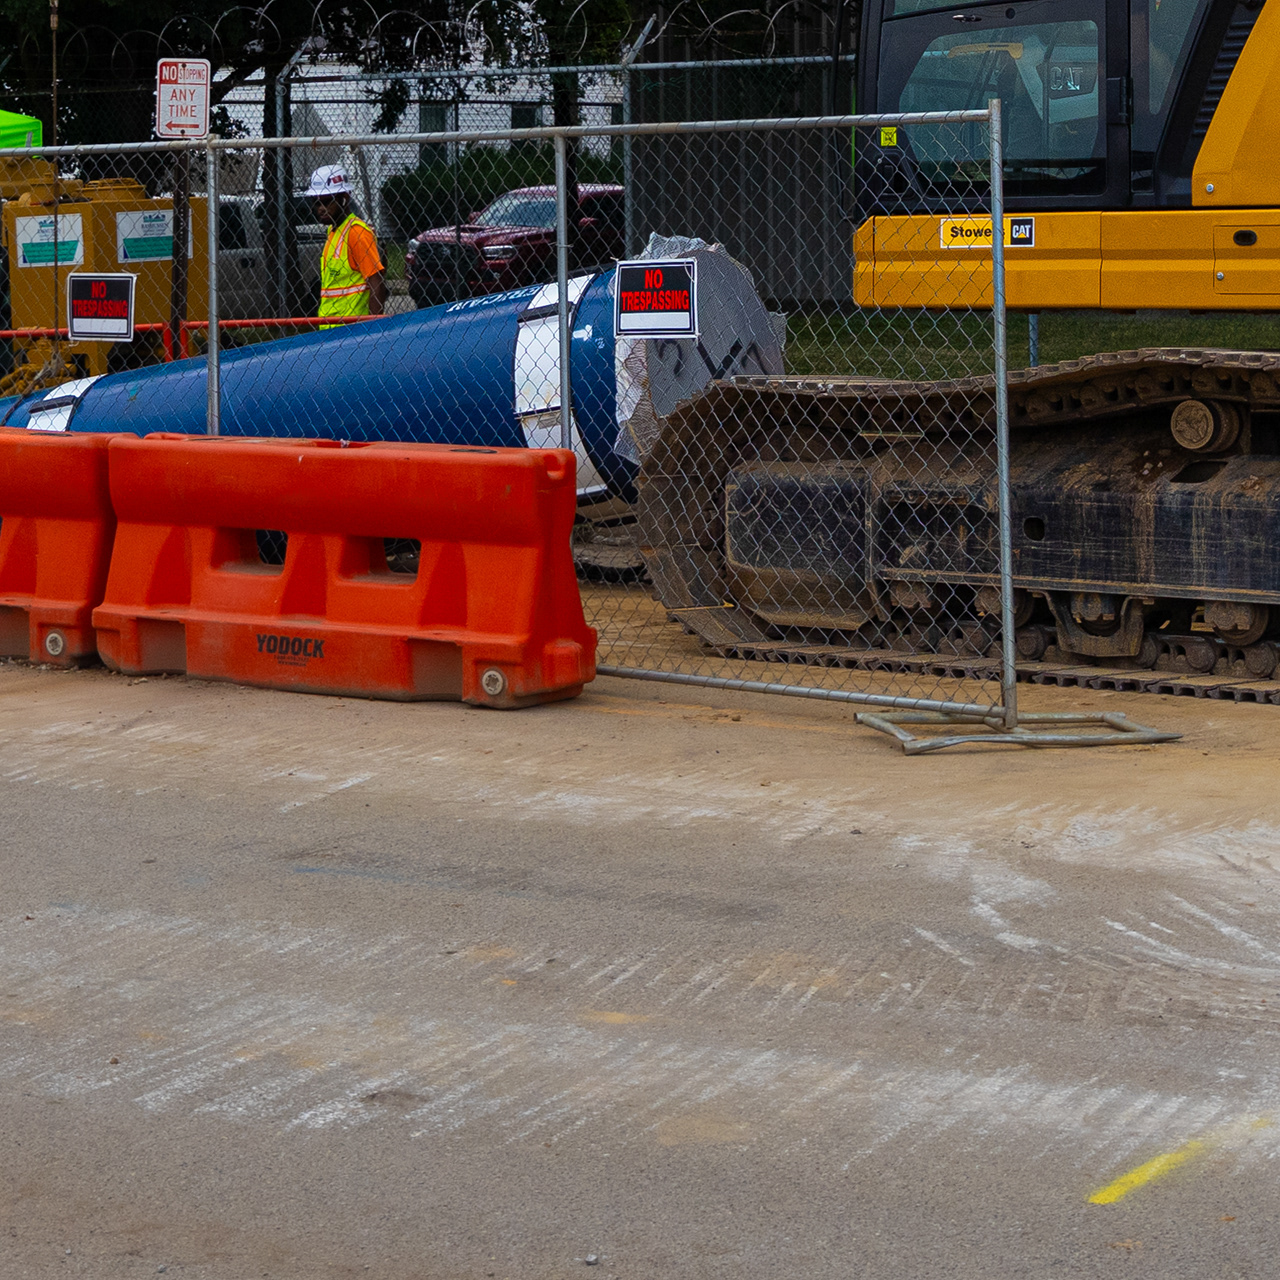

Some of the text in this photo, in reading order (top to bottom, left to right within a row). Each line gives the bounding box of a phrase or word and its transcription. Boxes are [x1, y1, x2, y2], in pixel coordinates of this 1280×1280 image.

[162, 66, 205, 80] NO STOPPING
[1050, 66, 1083, 90] CAT
[170, 88, 196, 101] ANY
[168, 104, 197, 118] TIME
[950, 224, 1031, 238] Stowe CAT
[644, 269, 663, 289] NO
[91, 281, 107, 299] NO
[72, 300, 129, 318] TRESPASSING
[621, 290, 690, 311] TRESPASSING
[256, 634, 325, 658] YODOCK
